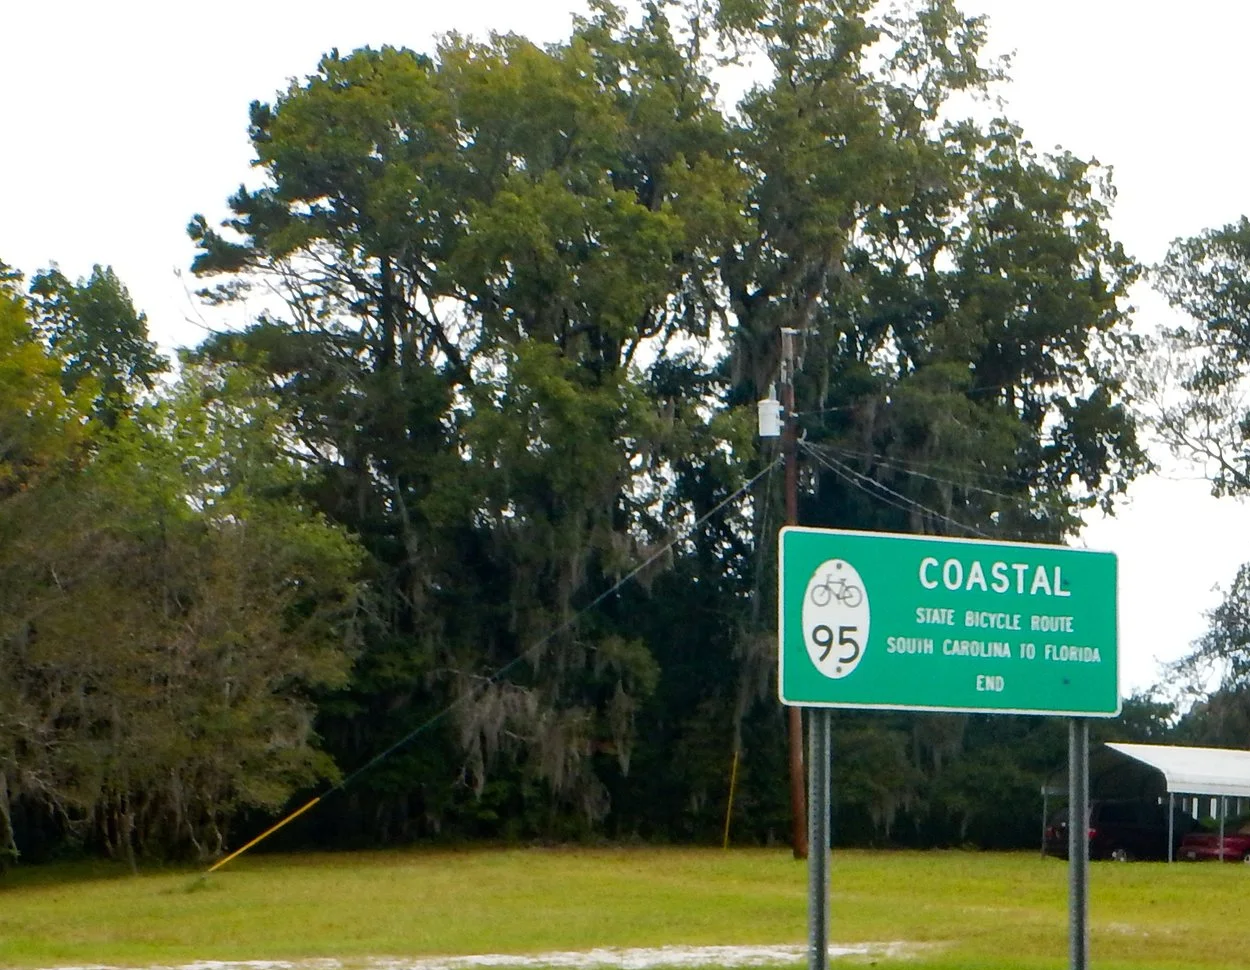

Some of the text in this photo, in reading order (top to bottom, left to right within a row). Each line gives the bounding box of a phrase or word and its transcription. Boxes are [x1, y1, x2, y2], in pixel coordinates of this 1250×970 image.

[919, 557, 1071, 597] COASTAL
[916, 607, 1075, 633] STATE BICYCLE ROUTE
[812, 624, 860, 664] 95
[887, 637, 1102, 663] SOUTH CAROLINA TO FLORIDA
[976, 674, 1004, 692] END
